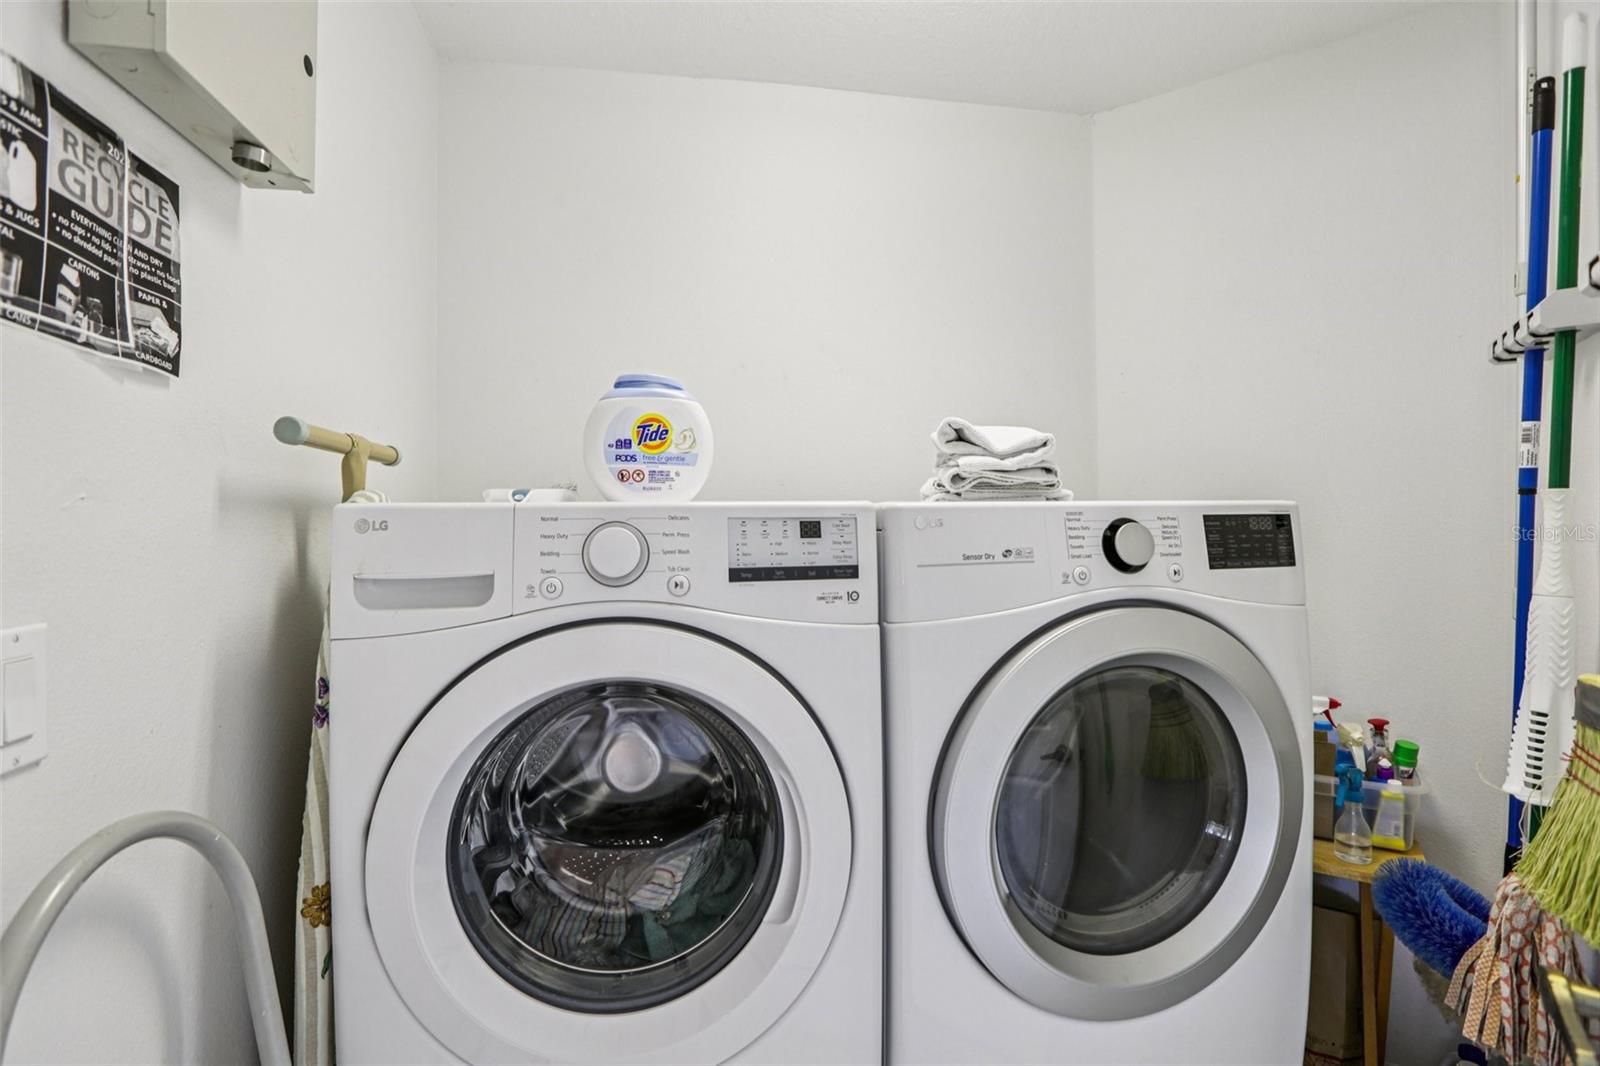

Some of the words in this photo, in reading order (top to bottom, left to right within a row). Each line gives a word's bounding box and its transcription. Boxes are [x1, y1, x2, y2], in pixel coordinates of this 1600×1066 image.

[20, 107, 42, 129] JARS
[57, 158, 173, 255] GUIDE
[15, 209, 41, 229] JUGS
[58, 215, 70, 227] no
[70, 222, 86, 238] caps
[70, 209, 113, 241] EVERYTHING
[133, 246, 149, 263] AND
[149, 255, 164, 271] DRY
[67, 257, 101, 282] CARTONS
[137, 290, 161, 306] PAPER
[6, 309, 33, 326] CANS
[134, 351, 173, 371] CARDBOARD
[637, 423, 669, 446] Tide
[615, 454, 637, 462] PODS
[642, 454, 656, 463] free
[665, 455, 686, 463] gentle
[372, 520, 388, 531] LG
[667, 514, 690, 522] Delicates
[540, 533, 555, 541] Heavy
[540, 550, 560, 558] Bedding
